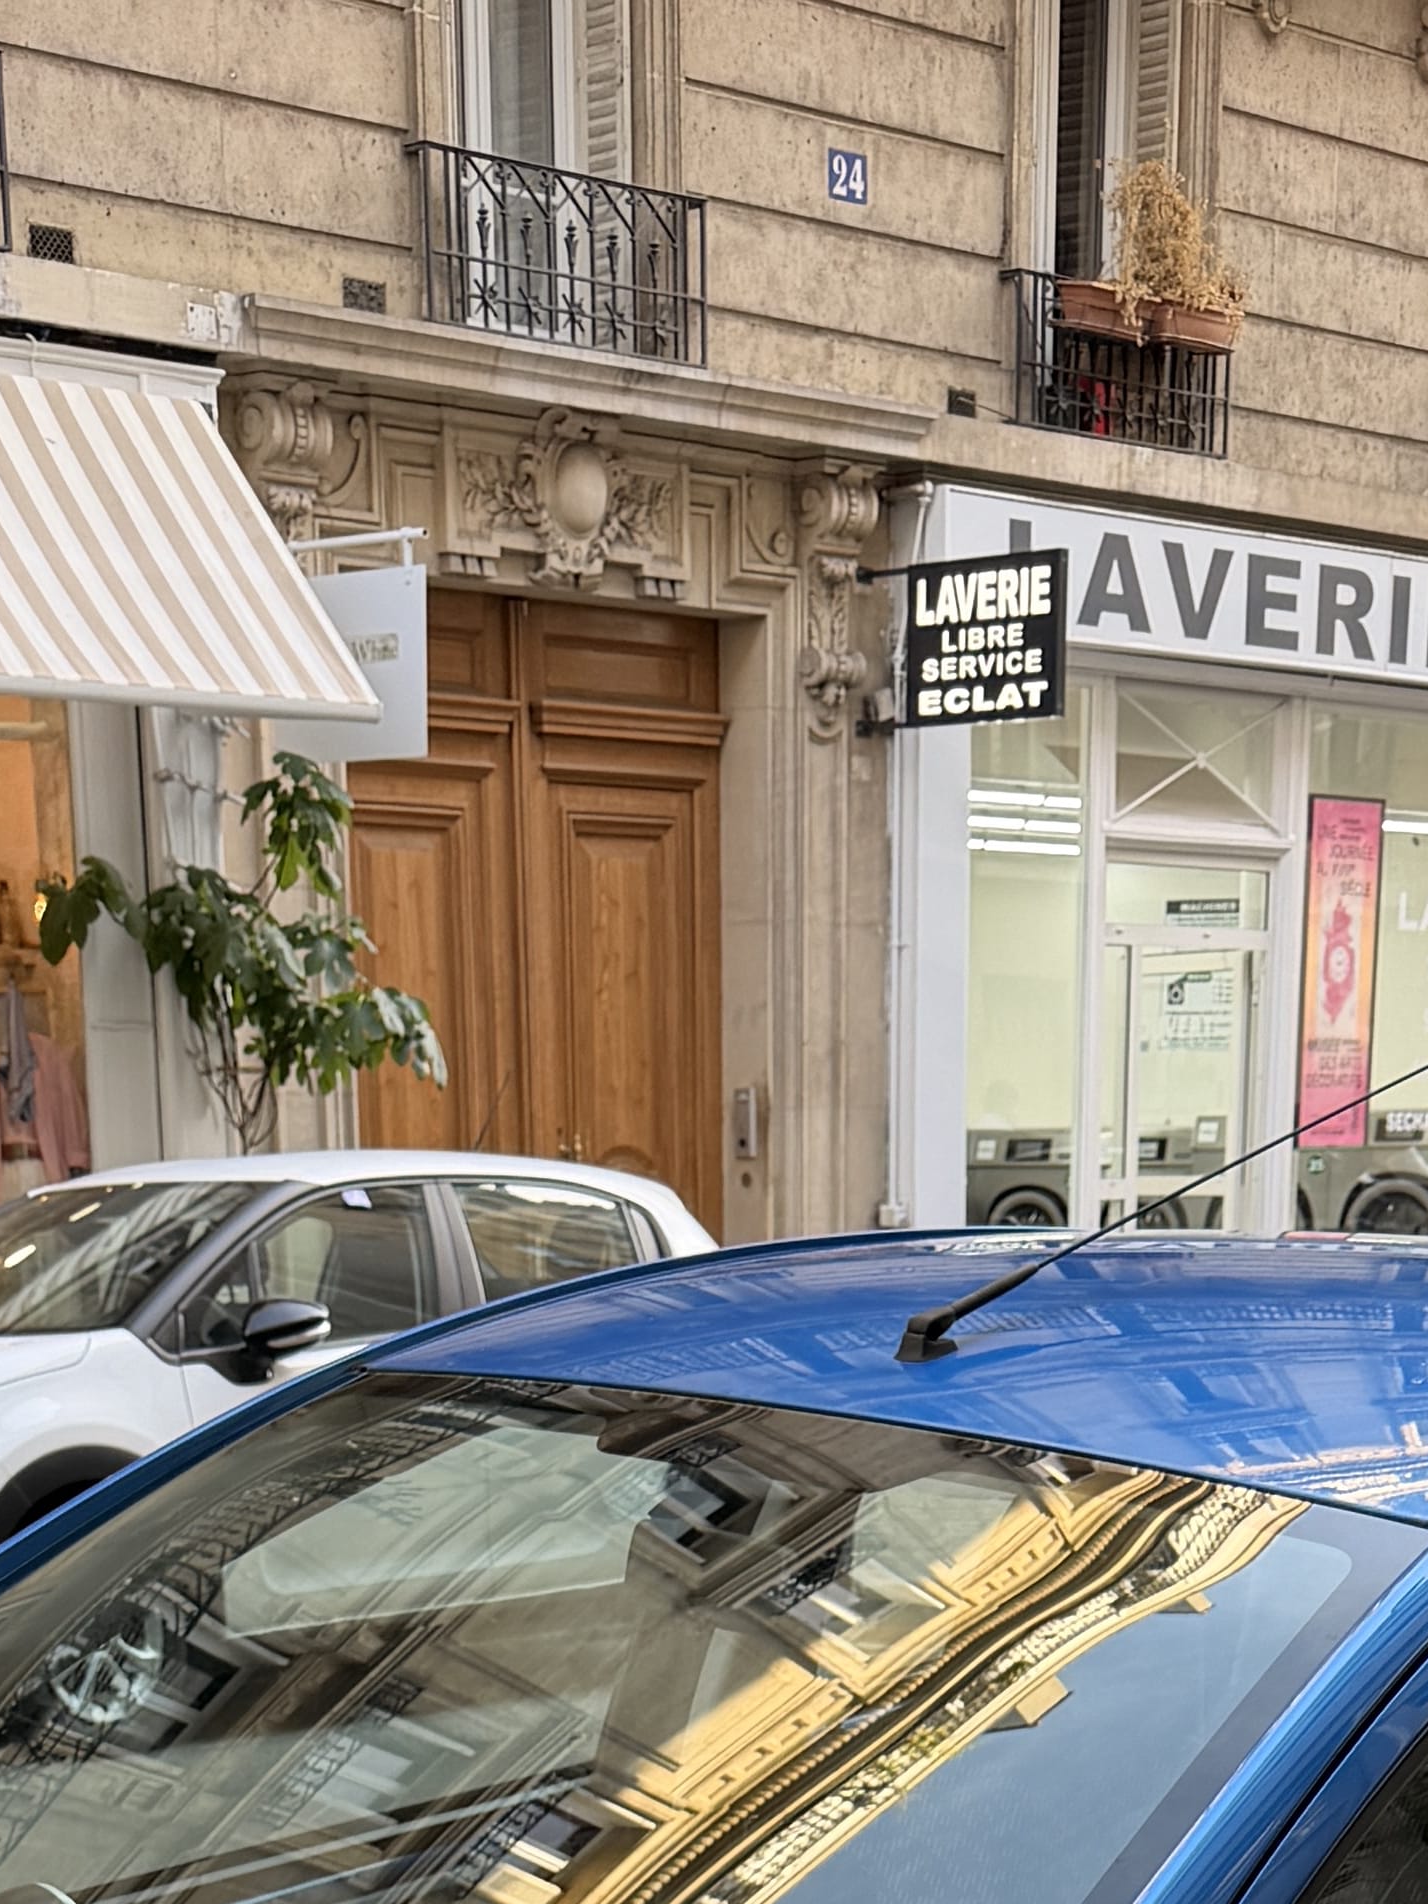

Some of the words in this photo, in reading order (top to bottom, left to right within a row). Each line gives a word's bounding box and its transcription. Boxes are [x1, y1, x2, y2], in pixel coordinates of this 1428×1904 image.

[832, 154, 865, 199] 24
[916, 565, 1052, 626] LAVERIE
[941, 623, 1024, 653] LIBRE
[922, 648, 1043, 683] SERVICE
[918, 681, 1049, 716] ECLAT
